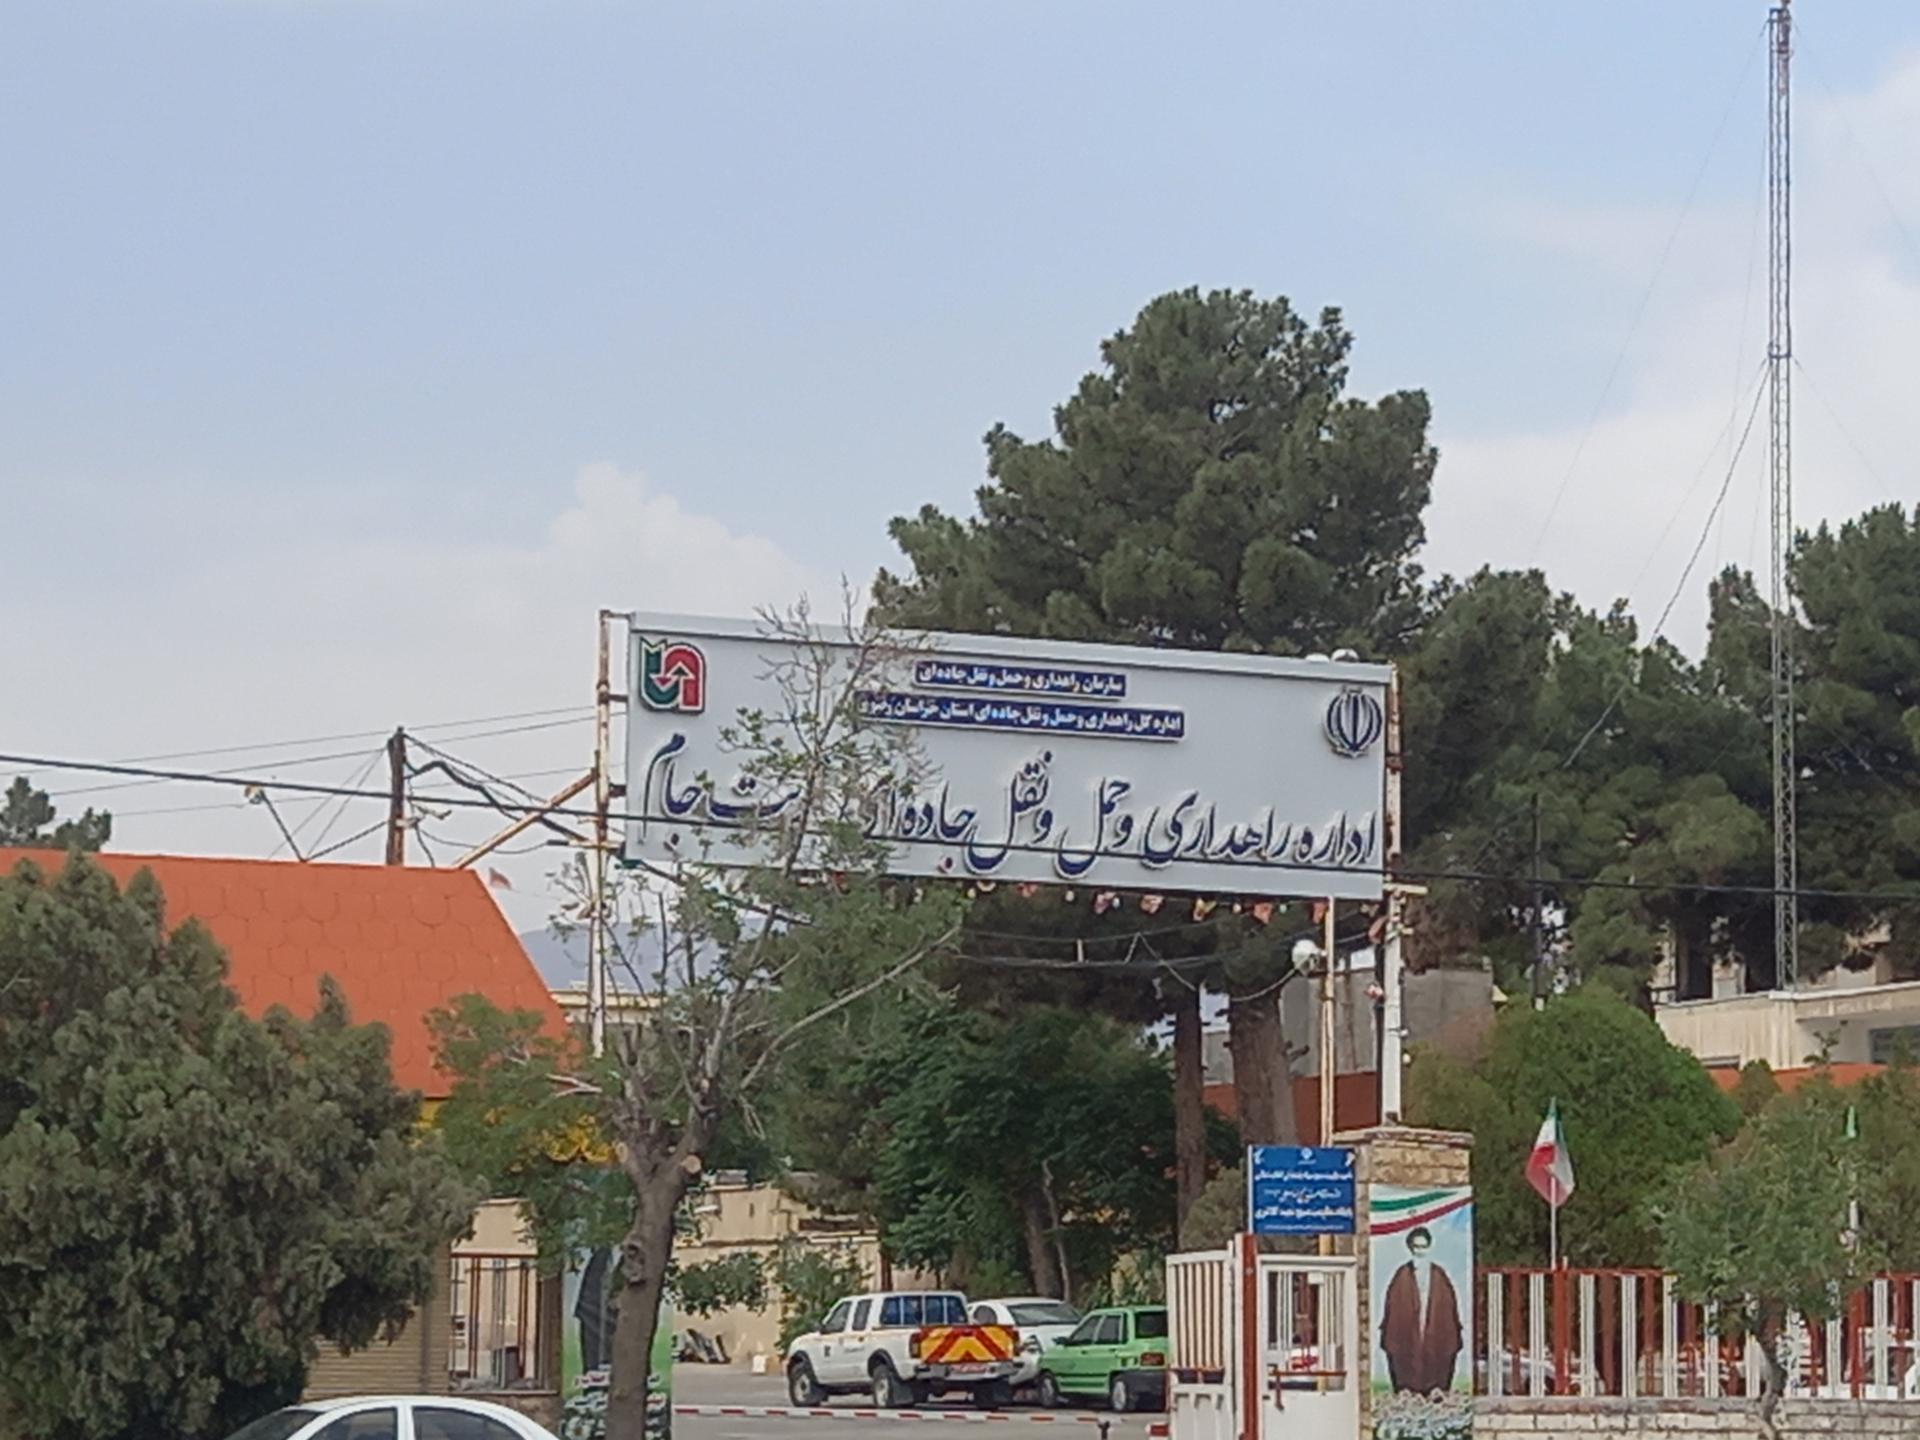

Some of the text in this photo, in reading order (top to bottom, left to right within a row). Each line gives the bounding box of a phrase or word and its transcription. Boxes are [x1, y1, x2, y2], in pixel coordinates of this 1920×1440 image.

[1032, 672, 1080, 693] راهداری
[895, 697, 939, 719] خراسان
[940, 701, 975, 720] استان
[1085, 711, 1134, 732] راهداری
[1134, 713, 1153, 732] کل
[1153, 715, 1181, 734] اداره
[1143, 793, 1291, 866] راهداری
[1298, 812, 1377, 865] اداره
